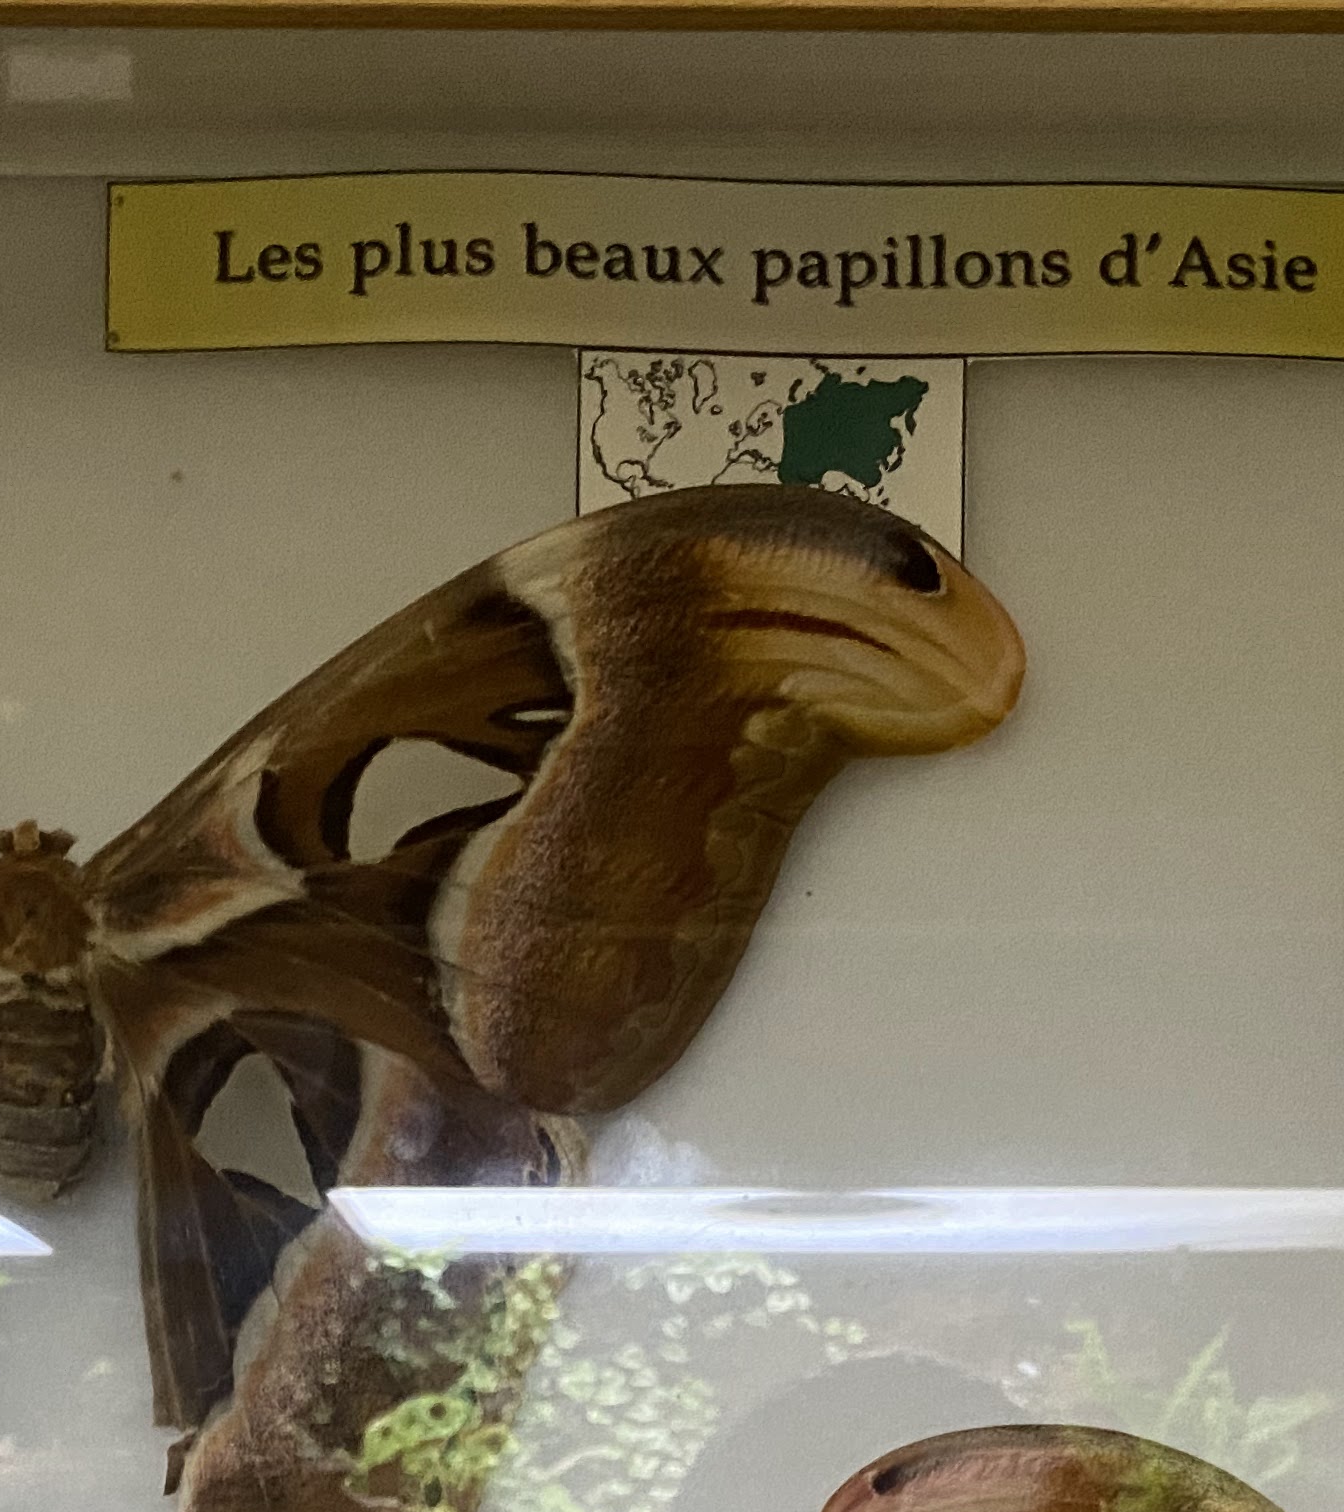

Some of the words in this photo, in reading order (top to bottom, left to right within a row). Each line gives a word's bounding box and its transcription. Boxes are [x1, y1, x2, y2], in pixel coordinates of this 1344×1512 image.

[213, 230, 323, 284] Les
[349, 222, 495, 296] plus
[522, 222, 724, 286] beaux
[751, 234, 1072, 308] papillons
